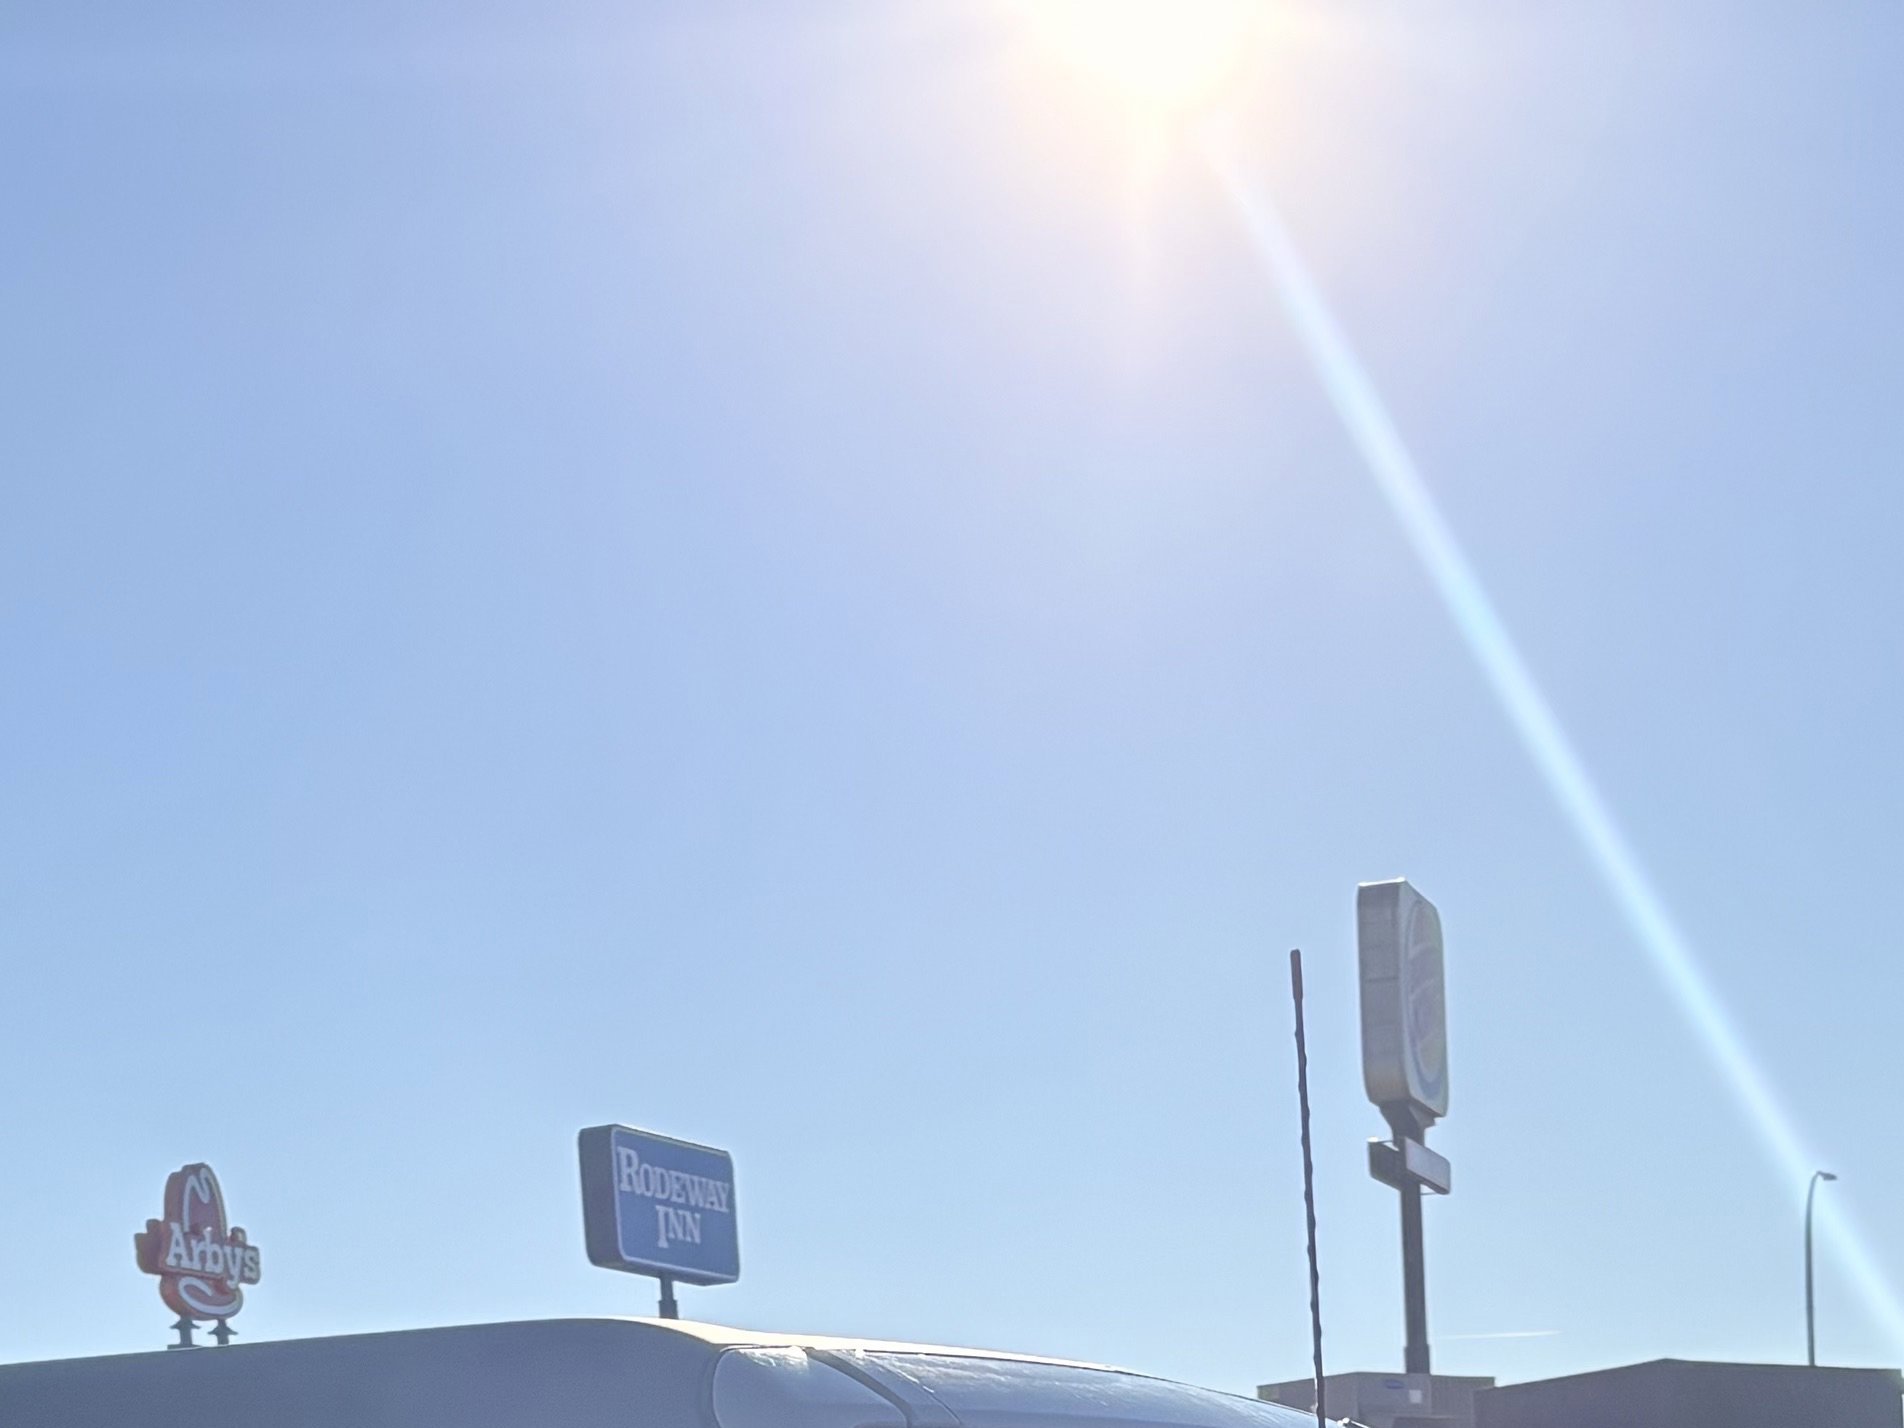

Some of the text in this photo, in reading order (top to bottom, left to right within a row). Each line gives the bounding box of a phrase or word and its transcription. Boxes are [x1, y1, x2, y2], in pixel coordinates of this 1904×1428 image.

[617, 1146, 730, 1213] RODEWAY
[165, 1221, 259, 1289] Arby's
[655, 1205, 701, 1249] INN
